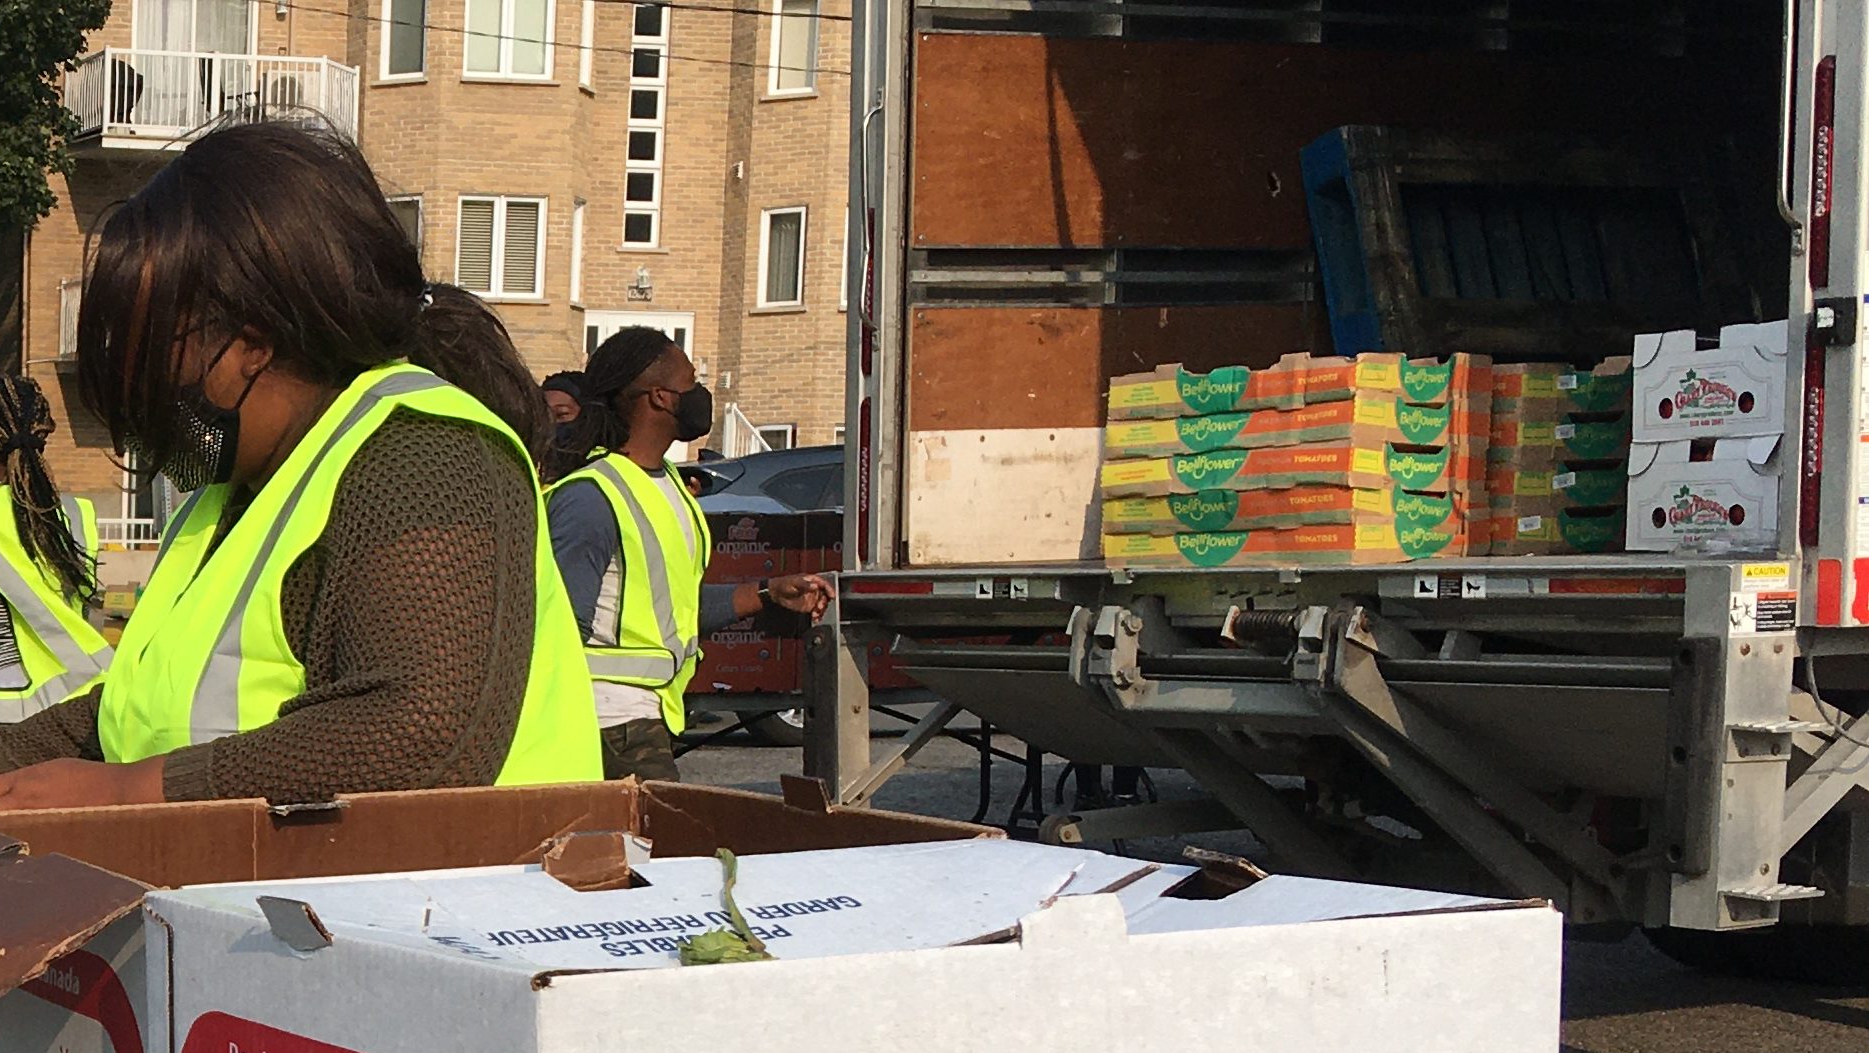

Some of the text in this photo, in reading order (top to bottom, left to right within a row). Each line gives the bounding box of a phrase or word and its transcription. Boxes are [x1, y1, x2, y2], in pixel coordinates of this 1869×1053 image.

[1177, 455, 1237, 478] Bellflower
[1293, 454, 1338, 464] TOMATOES
[1389, 456, 1440, 477] Bellflower
[1295, 534, 1338, 544] TOMATOES
[1754, 566, 1786, 576] CAUTION
[746, 895, 863, 920] GARDER
[41, 965, 81, 997] anada
